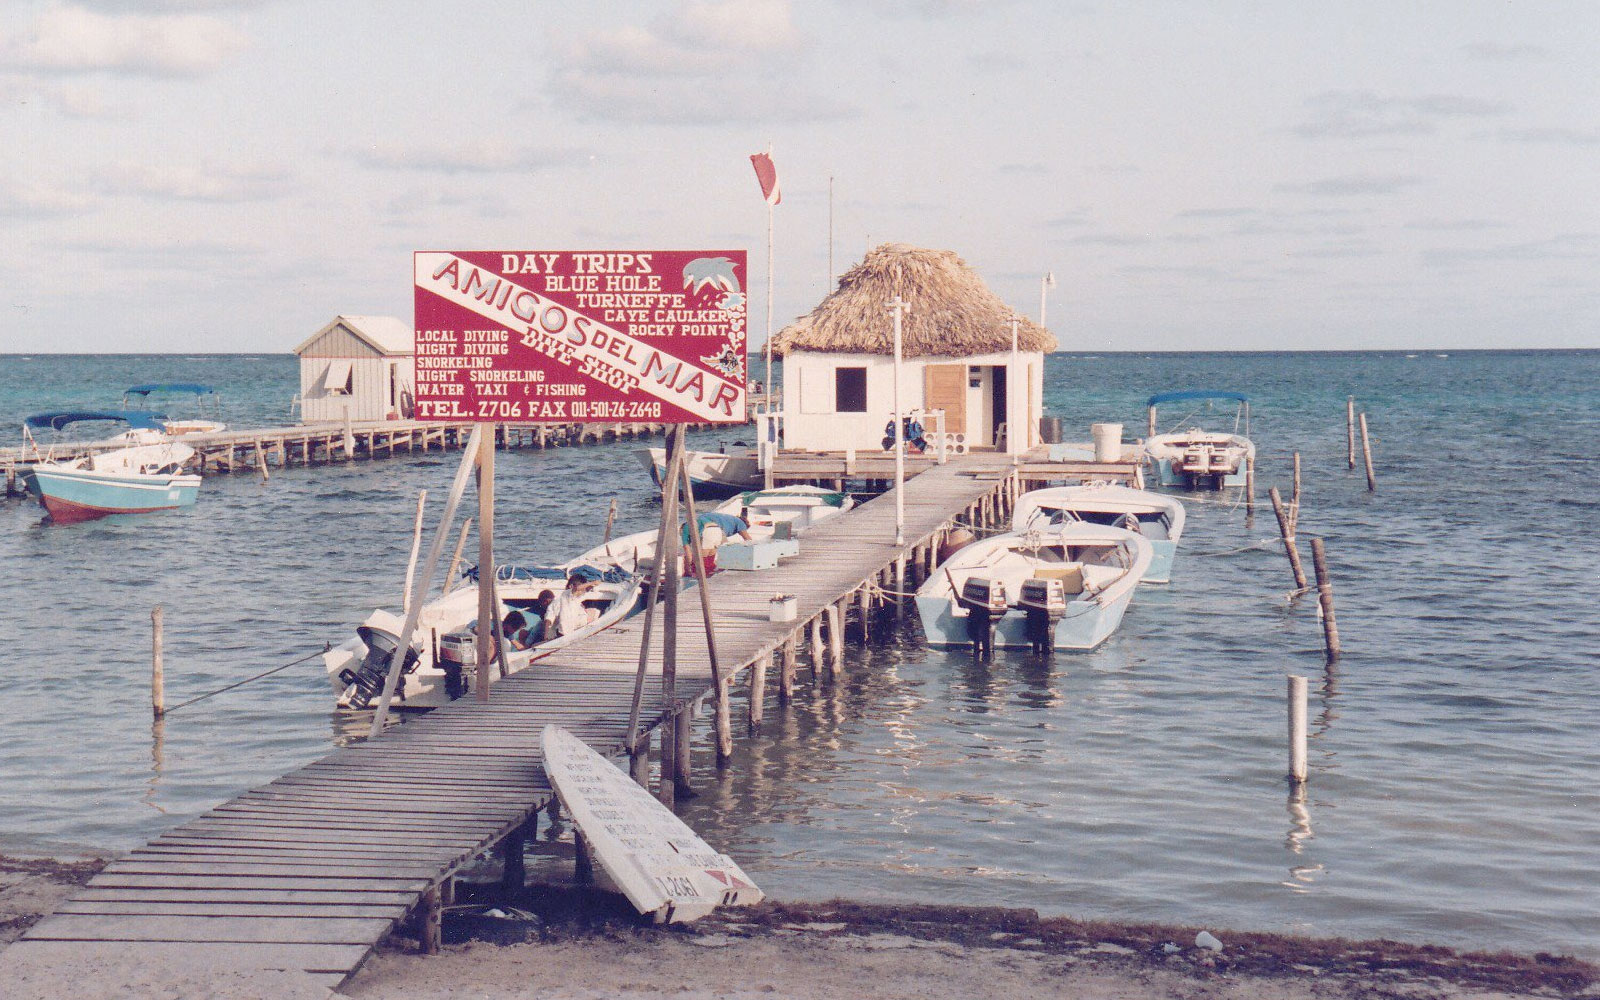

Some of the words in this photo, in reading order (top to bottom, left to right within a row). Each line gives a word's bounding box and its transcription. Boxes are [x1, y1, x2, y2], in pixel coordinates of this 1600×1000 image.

[501, 254, 560, 274] DAY
[572, 253, 653, 273] TRIPS
[545, 275, 598, 292] BLUE
[605, 275, 661, 291] HOLE
[576, 294, 685, 308] TURNEFFE
[604, 310, 649, 322] CAYE
[654, 310, 728, 322] CAULKER
[416, 330, 457, 342] LOCAL
[463, 330, 509, 342] DIVING
[628, 324, 675, 336] ROCKY
[681, 324, 728, 336] POINT
[432, 258, 591, 346] AMIGOS
[590, 329, 637, 366] DEL
[640, 351, 739, 417] MAR
[416, 343, 457, 355] NIGHT
[463, 343, 509, 355] DIVING
[417, 357, 493, 368] SNORKELING
[520, 326, 576, 366] DIVE
[577, 354, 640, 395] SHOP
[416, 370, 458, 382] NIGHT
[469, 370, 545, 382] SNORKELING
[417, 384, 465, 395] WATER
[475, 384, 508, 395] TAXI
[536, 384, 587, 396] FISHING
[417, 400, 474, 417] TEL.
[478, 401, 521, 417] 2706
[528, 402, 567, 417] FAX
